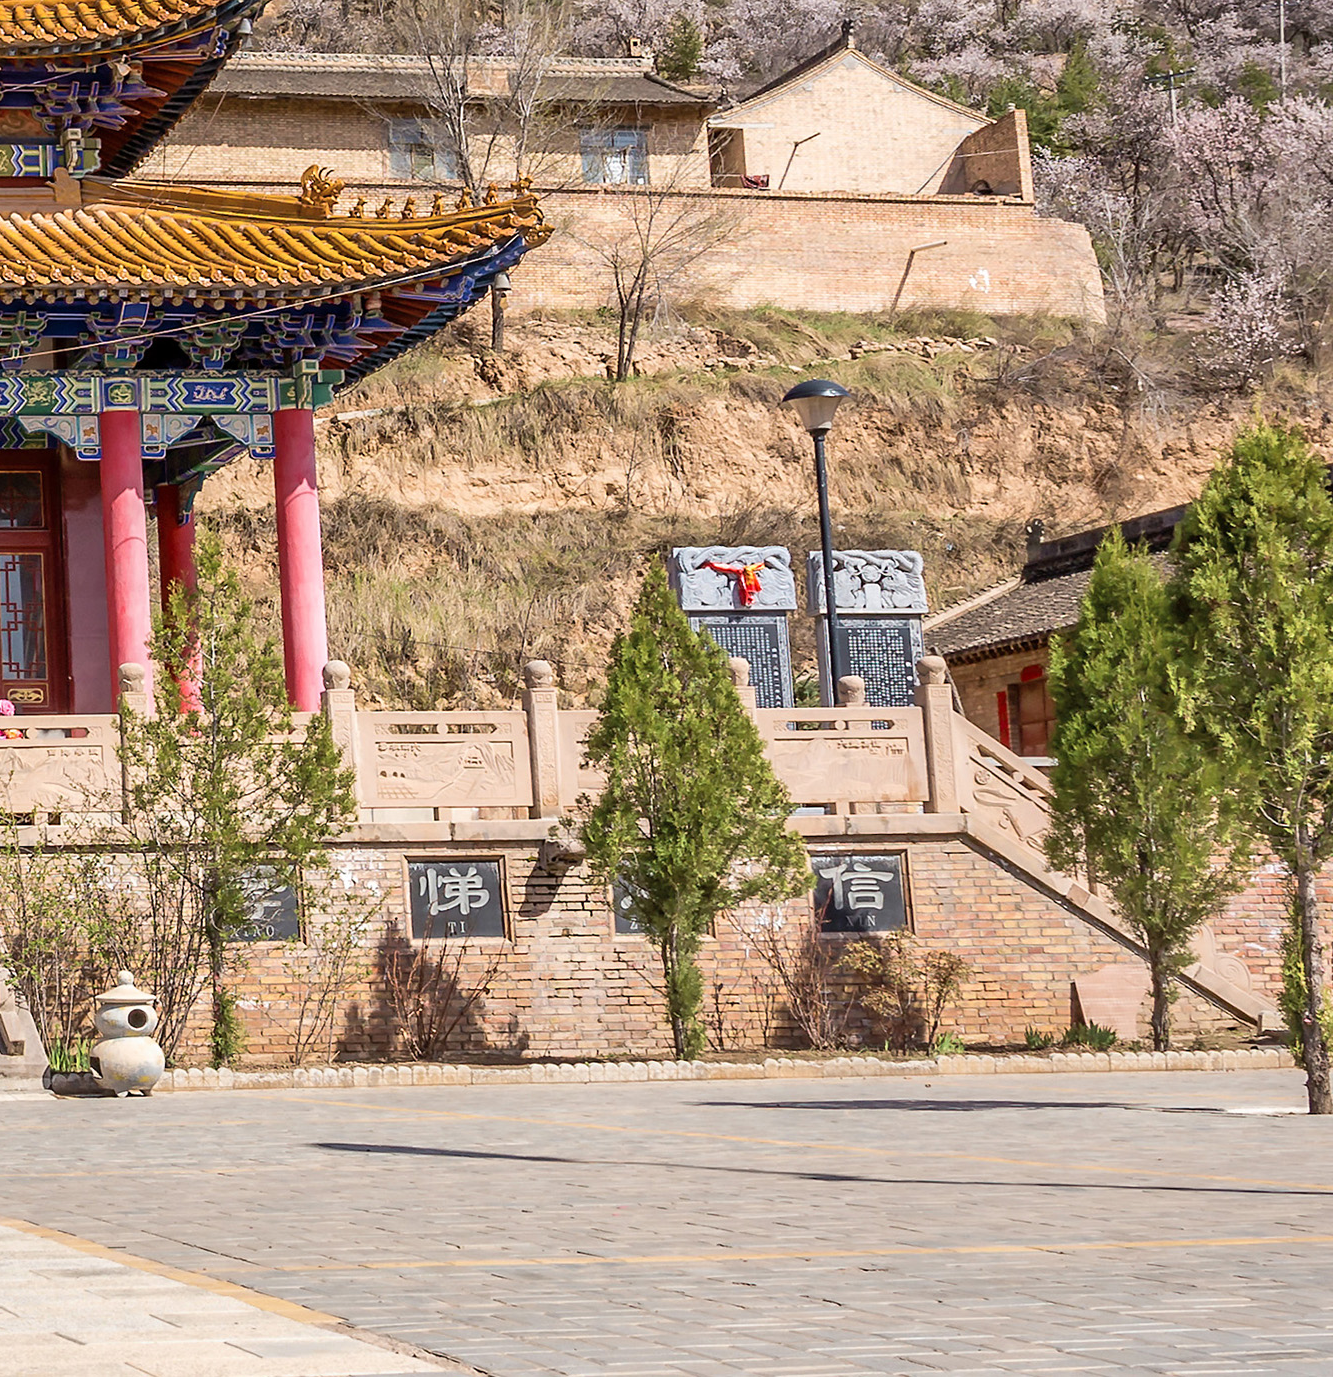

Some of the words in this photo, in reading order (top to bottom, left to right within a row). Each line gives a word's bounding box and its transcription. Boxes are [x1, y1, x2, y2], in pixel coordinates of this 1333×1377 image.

[419, 867, 490, 916] 悌
[819, 862, 894, 910] 信
[447, 921, 466, 934] TI
[845, 915, 876, 927] XIN
